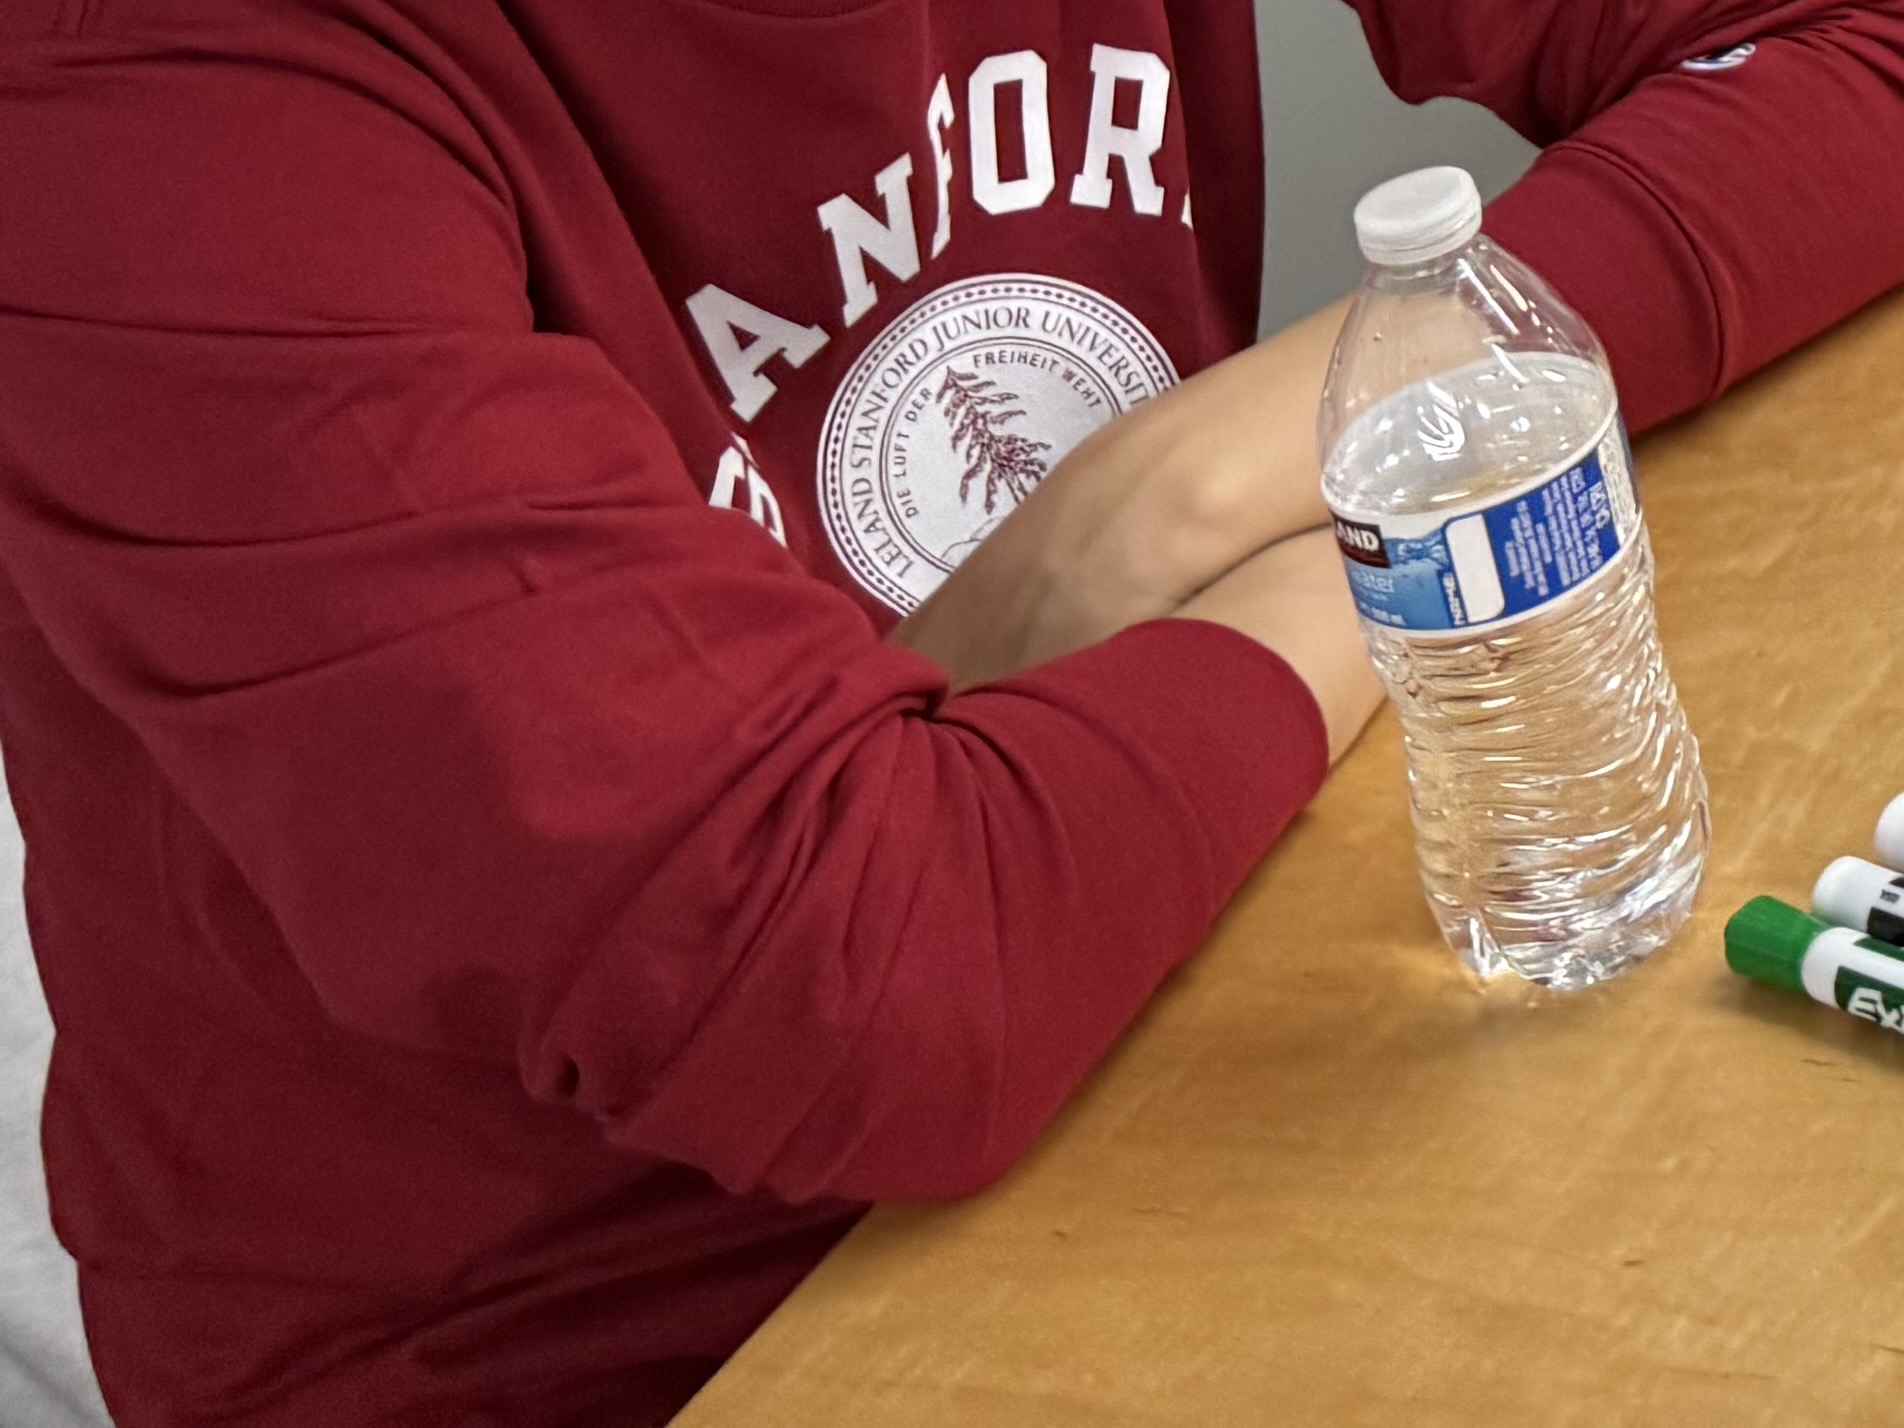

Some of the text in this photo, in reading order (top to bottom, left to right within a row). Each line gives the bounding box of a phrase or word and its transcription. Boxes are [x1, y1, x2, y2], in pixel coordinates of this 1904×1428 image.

[851, 305, 1150, 580] LELAND STANFORD JUNIOR UNIVERSIT
[893, 349, 1103, 519] DIE LUFT DER FREIHEIT WEHT
